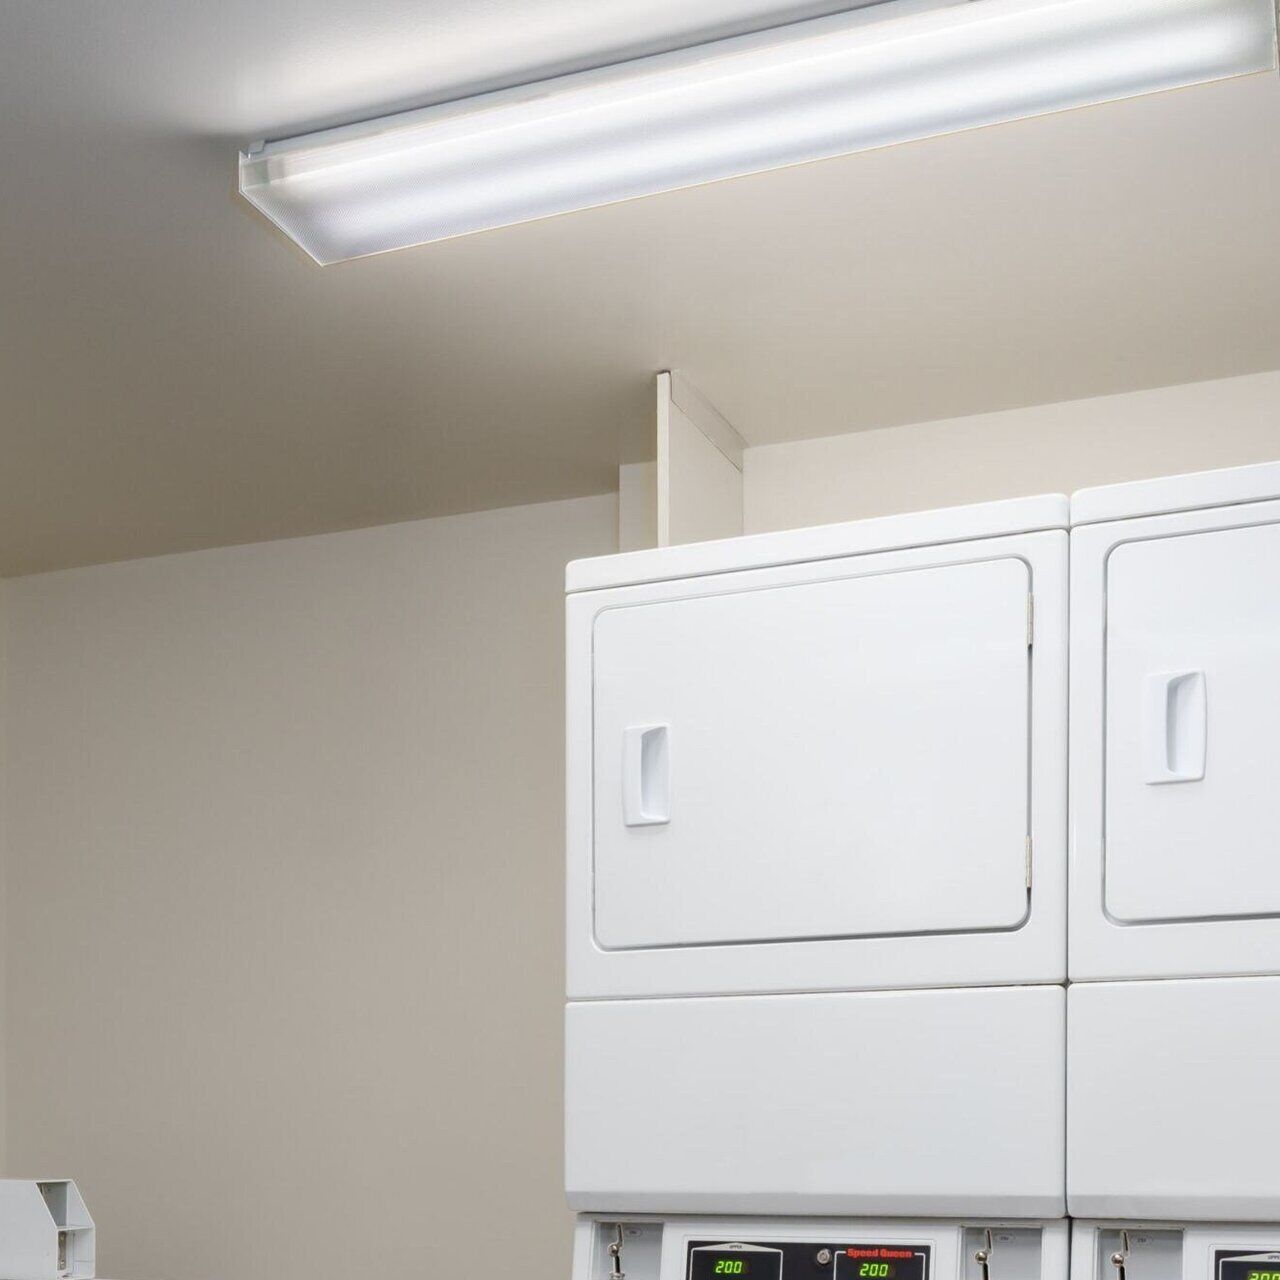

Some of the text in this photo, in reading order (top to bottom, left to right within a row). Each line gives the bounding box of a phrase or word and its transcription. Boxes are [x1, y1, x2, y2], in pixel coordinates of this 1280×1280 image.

[847, 1248, 912, 1258] Speed Queen
[715, 1260, 743, 1274] 200
[859, 1263, 889, 1277] 200
